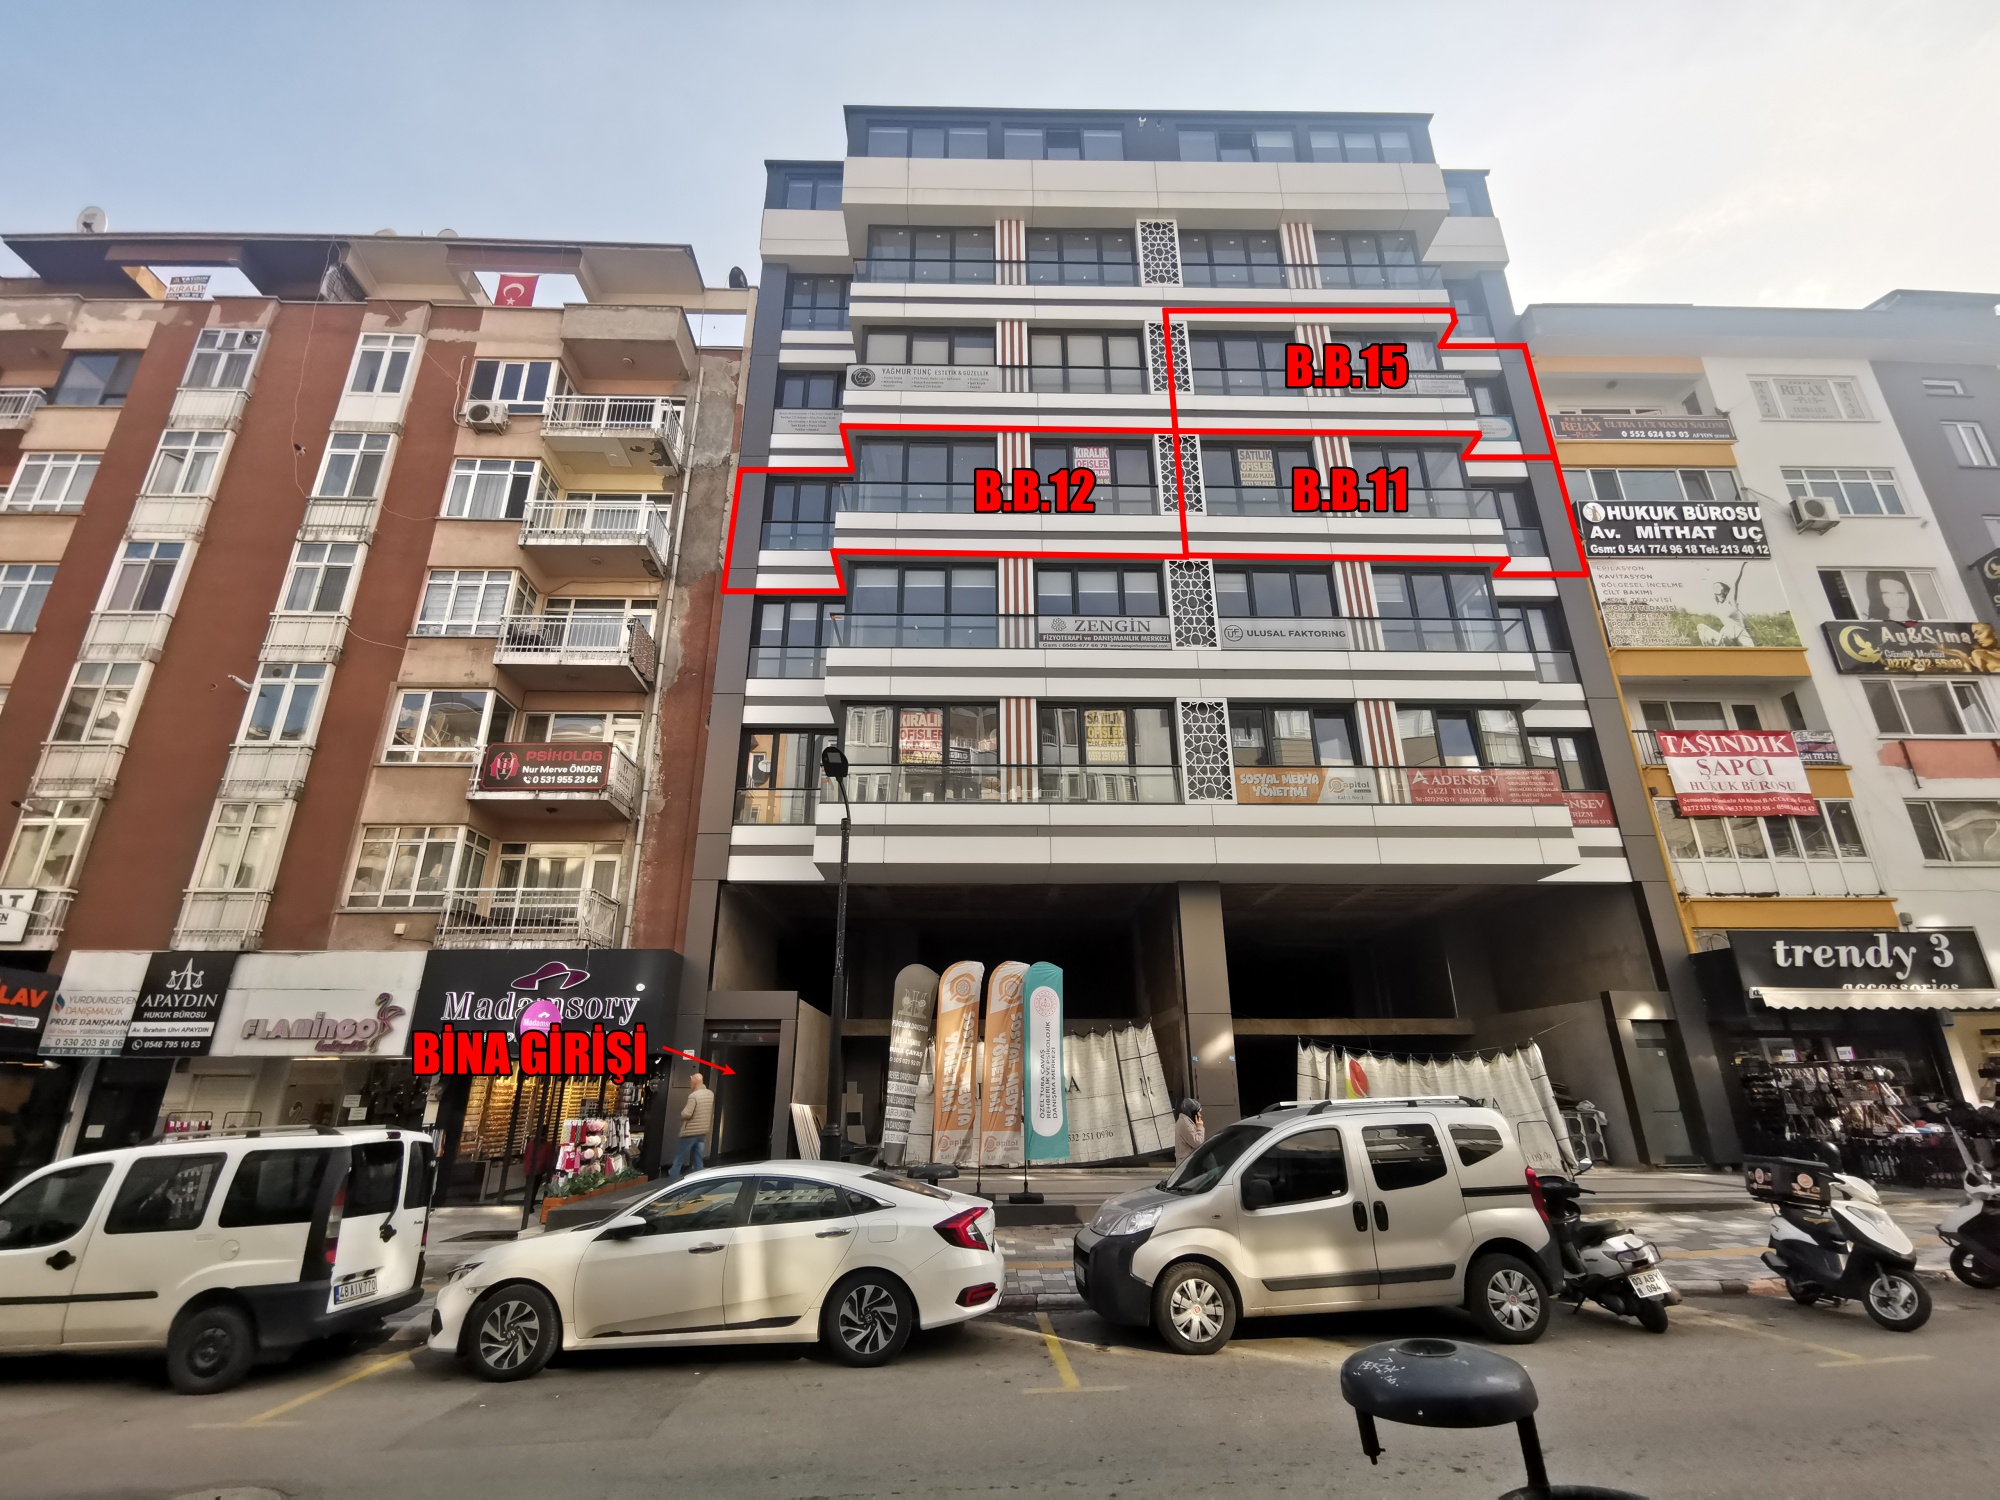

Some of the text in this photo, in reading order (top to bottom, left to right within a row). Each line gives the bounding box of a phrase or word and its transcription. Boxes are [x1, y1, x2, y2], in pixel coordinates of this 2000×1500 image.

[882, 368, 911, 376] YAĞMUR
[913, 368, 932, 376] TUNÇ
[1780, 385, 1825, 396] RELAX
[1560, 422, 1602, 431] RELAX
[1075, 447, 1108, 458] KIRALIK
[1239, 451, 1272, 460] SATILIK
[1607, 504, 1762, 521] HUKUK BÜROSU
[1590, 523, 1763, 542] Av. MİTHAT UÇ
[1590, 544, 1769, 554] Gsm: 0 541 774 96 18 Tel: 213 40 12
[1075, 618, 1151, 632] ZENGİN
[1660, 735, 1794, 756] TAŞINDIK
[525, 748, 603, 762] PSİKOLOG
[522, 764, 602, 773] Nur Merve ÖNDER
[532, 776, 598, 784] 0 531 955 23 64
[1240, 774, 1319, 785] SOSYAL MEDYA
[1432, 775, 1499, 785] ADENSEV
[1690, 779, 1796, 791] HUKUK BÜROSU
[1451, 787, 1485, 795] TURİZM
[1772, 933, 1954, 980] trendy 3
[69, 996, 138, 1005] YURDUNUSEVEN
[141, 994, 218, 1007] APAYDIN
[65, 1007, 124, 1016] DANIŞMANLIK
[173, 1010, 207, 1018] BÜROSU
[441, 991, 640, 1026] Madsory
[50, 1018, 78, 1026] PROJE
[1005, 1011, 1023, 1127] SOSYAL MEDYA
[1082, 1132, 1094, 1141] 251
[1632, 1273, 1660, 1286] 03 ABY
